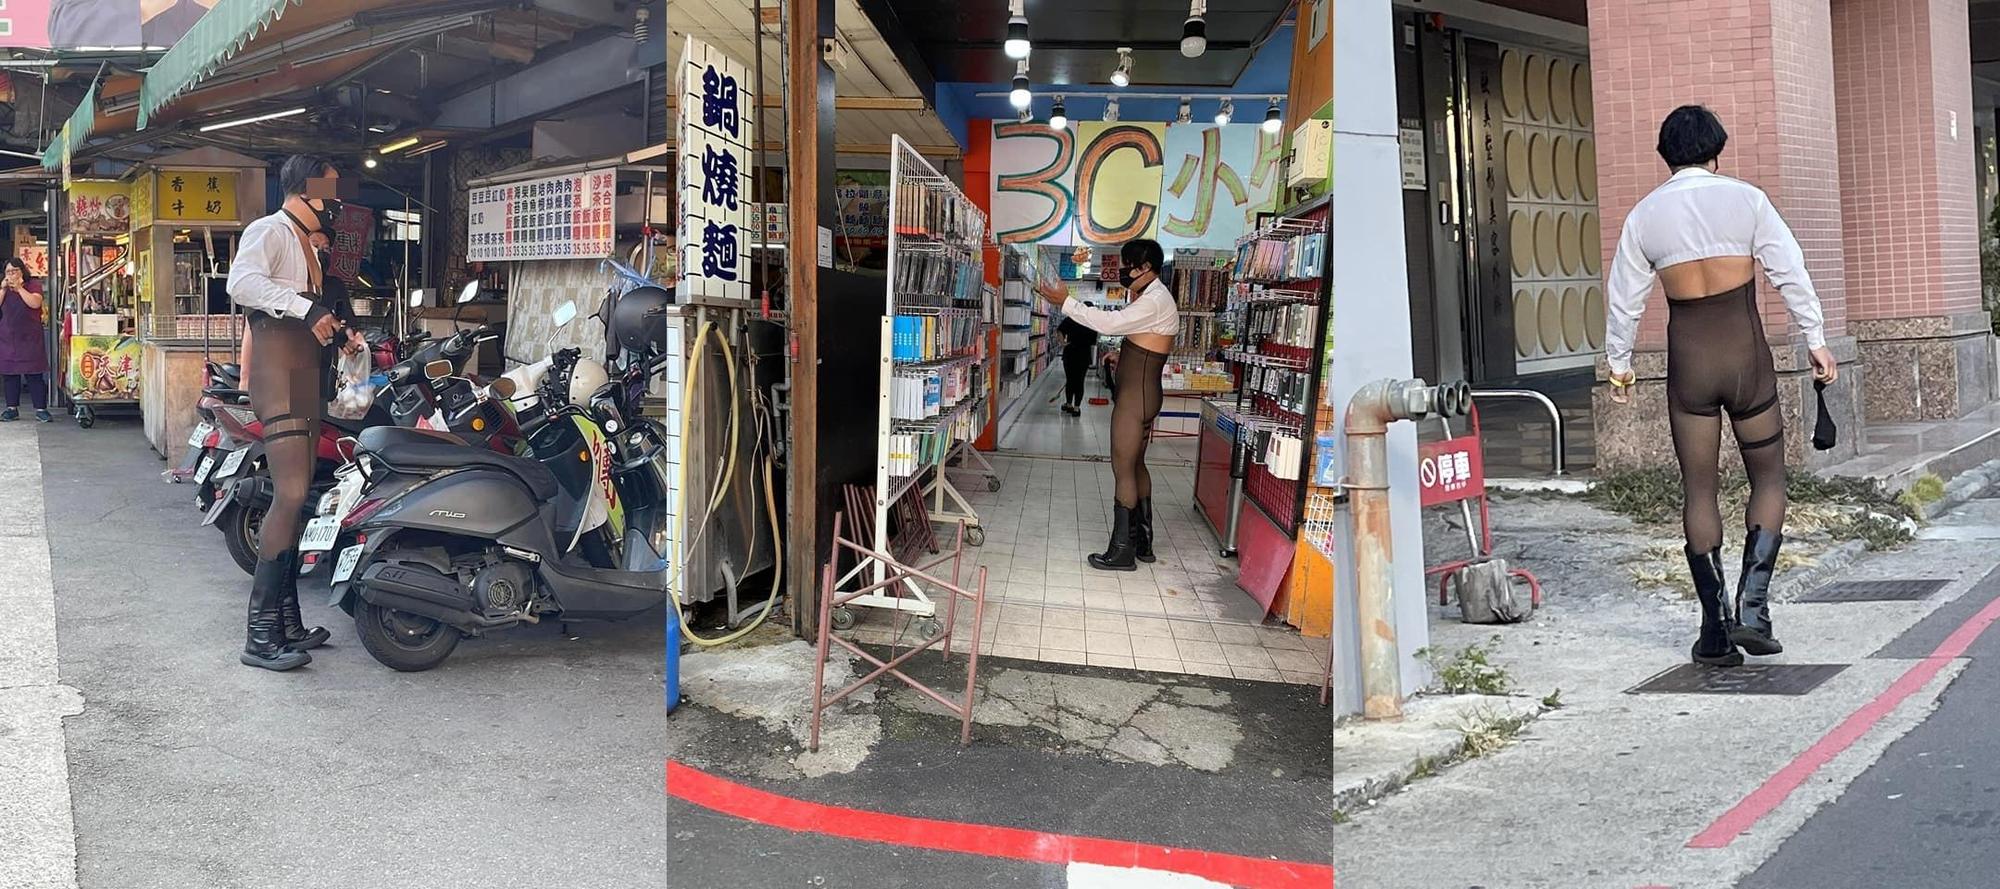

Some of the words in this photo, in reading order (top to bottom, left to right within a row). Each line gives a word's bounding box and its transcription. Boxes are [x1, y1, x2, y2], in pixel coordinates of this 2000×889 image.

[170, 176, 221, 194] 香蕉
[702, 64, 739, 282] 鍋燒麵
[170, 199, 222, 216] 牛奶
[1437, 451, 1471, 486] 停車
